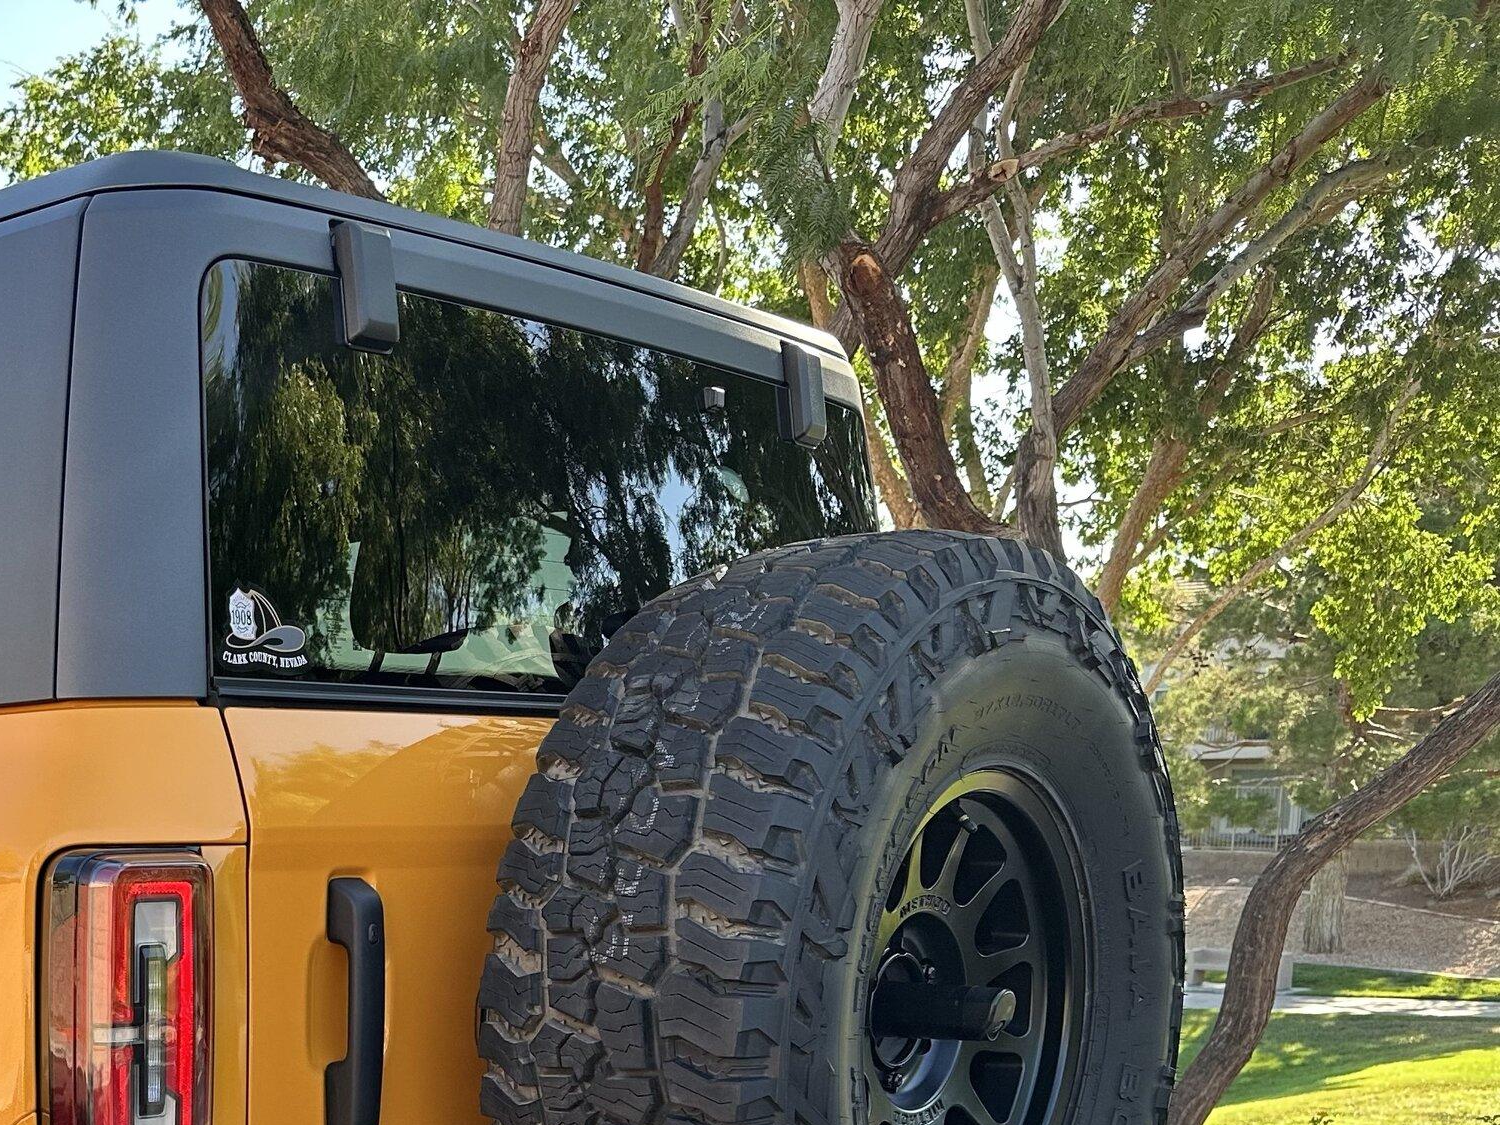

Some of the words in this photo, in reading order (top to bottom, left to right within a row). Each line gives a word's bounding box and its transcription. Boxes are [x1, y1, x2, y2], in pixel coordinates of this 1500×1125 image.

[231, 609, 252, 626] 1908
[222, 651, 248, 665] CLARK
[248, 652, 279, 669] COUNTY,
[279, 654, 308, 668] NEVADA
[1121, 857, 1152, 1021] BAJA
